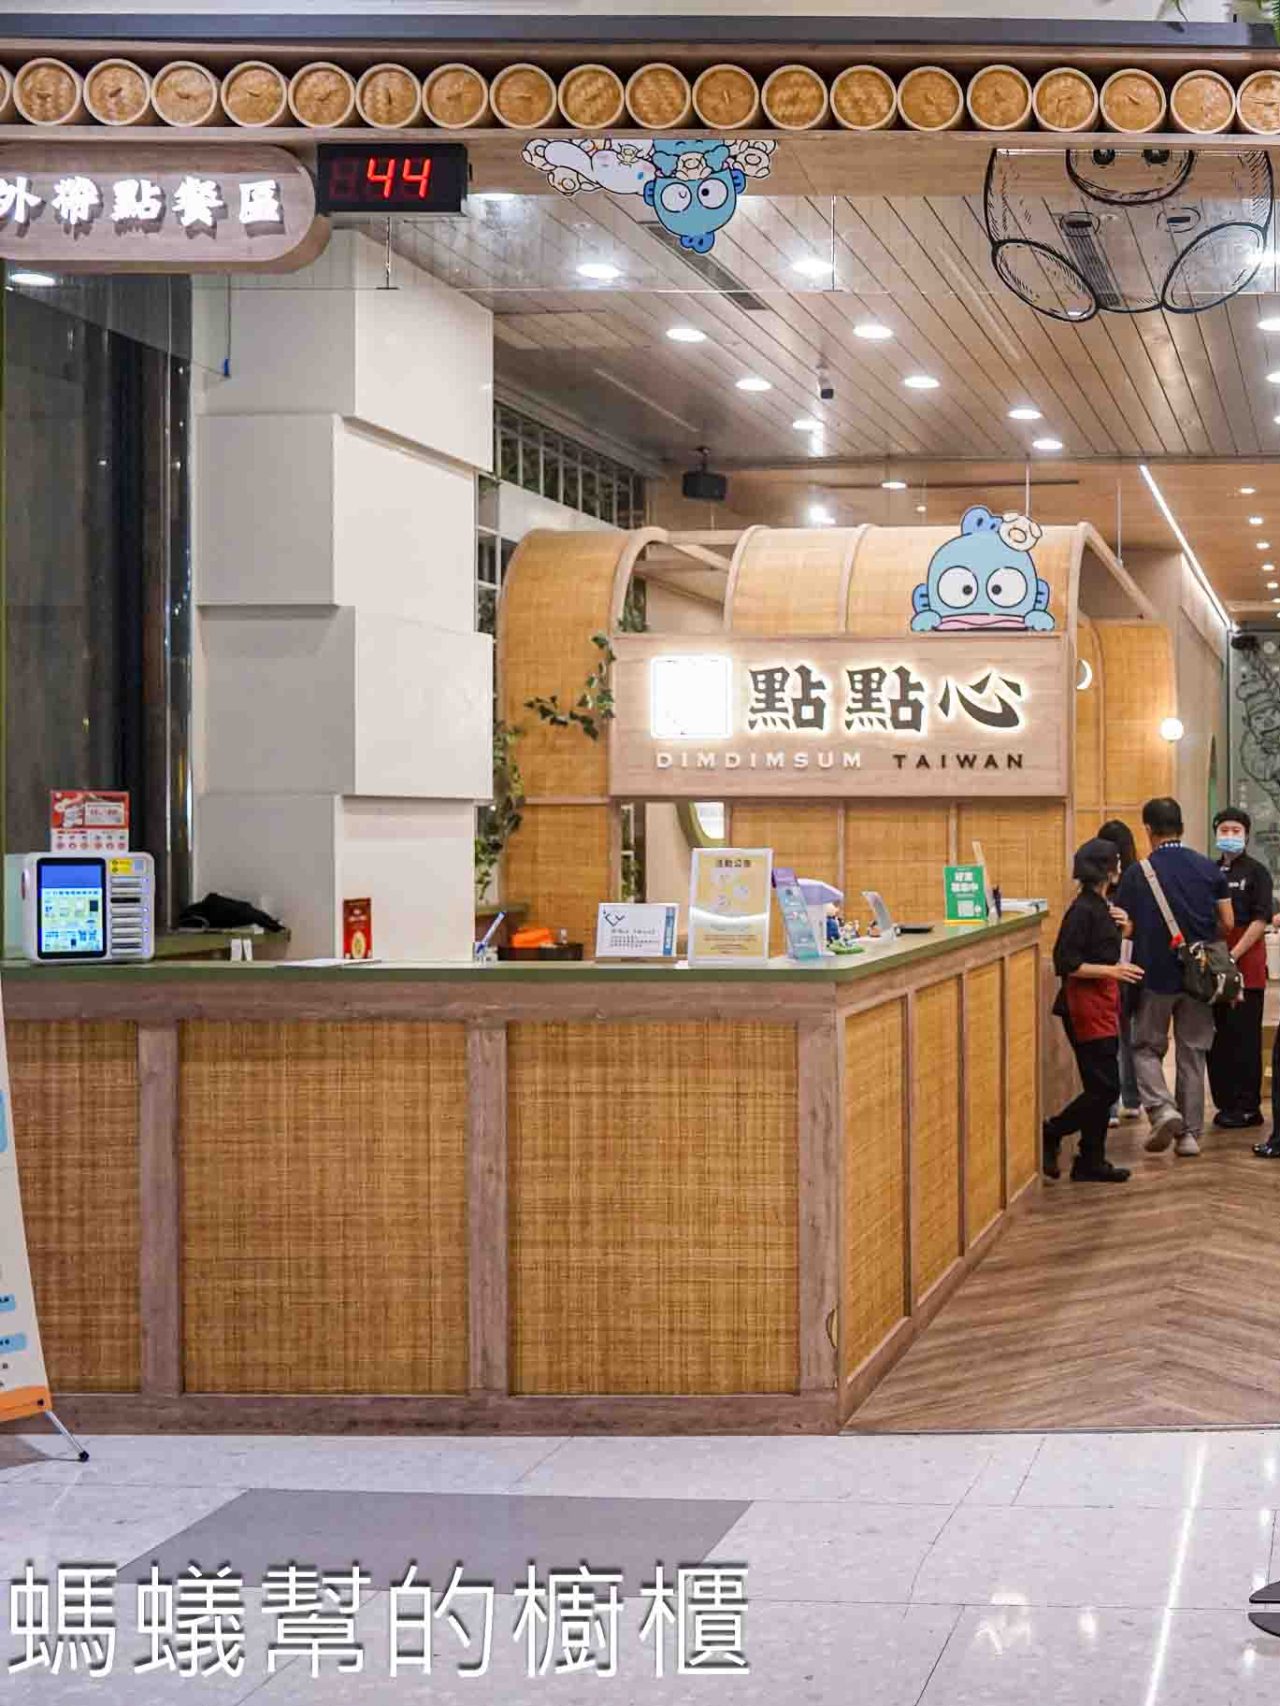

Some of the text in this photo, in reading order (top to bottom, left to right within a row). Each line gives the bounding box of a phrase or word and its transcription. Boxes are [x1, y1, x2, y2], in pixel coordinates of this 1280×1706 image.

[366, 157, 432, 198] 44
[0, 175, 281, 227] 外帶點餐區
[748, 663, 1024, 734] 點點心
[656, 751, 1025, 770] DIMDIMSUM TAIWAN
